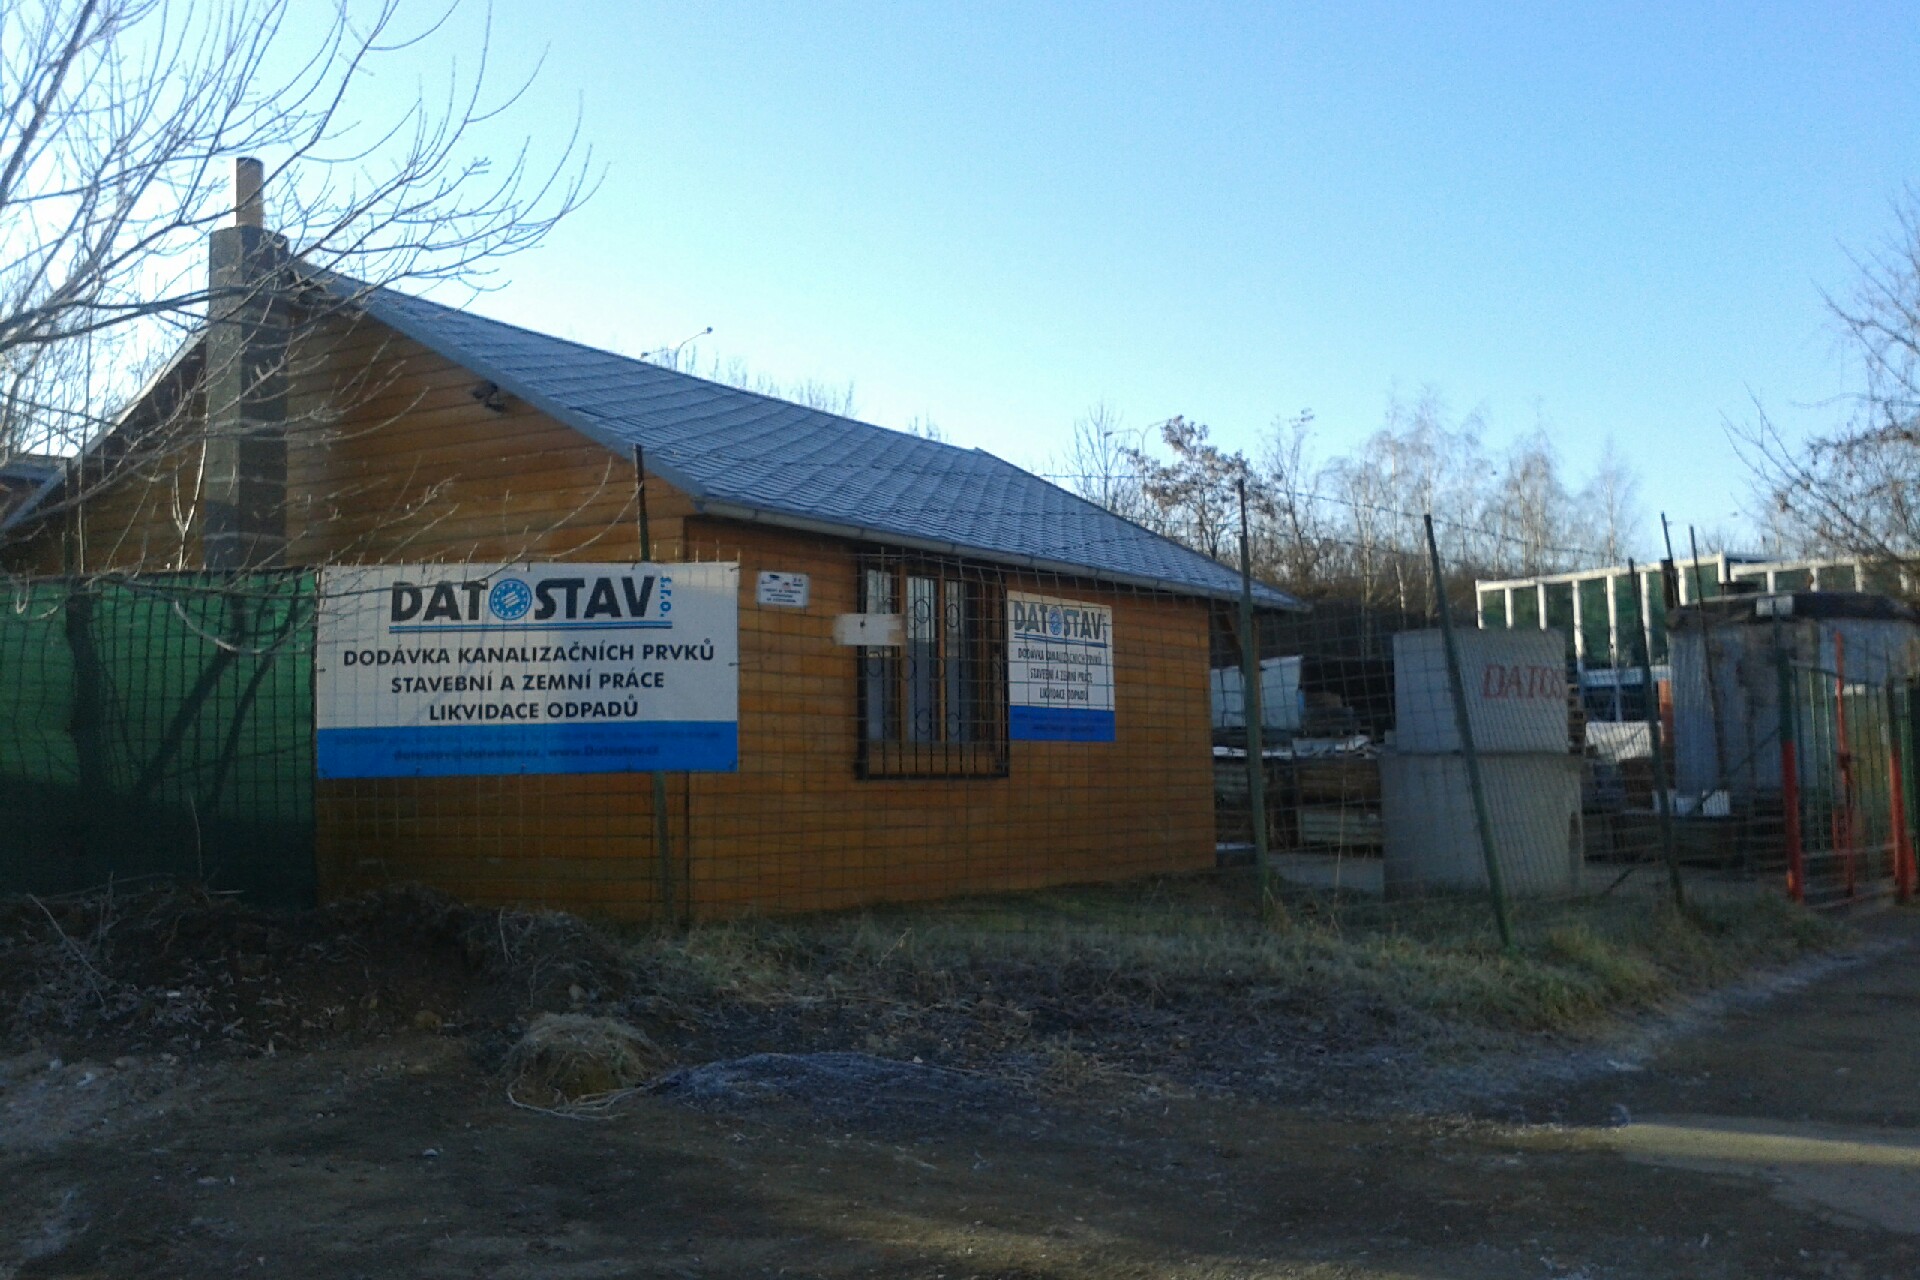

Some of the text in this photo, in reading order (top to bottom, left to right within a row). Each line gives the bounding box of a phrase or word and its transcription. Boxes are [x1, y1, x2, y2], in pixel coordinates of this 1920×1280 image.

[343, 637, 714, 666] DODÁVKA KANALIZAČNÍCH PRVKŮ
[391, 667, 665, 693] STAVEBNÍ A ZEMNÍ PRÁCE
[429, 694, 638, 721] LIKVIDACE ODPADŮ
